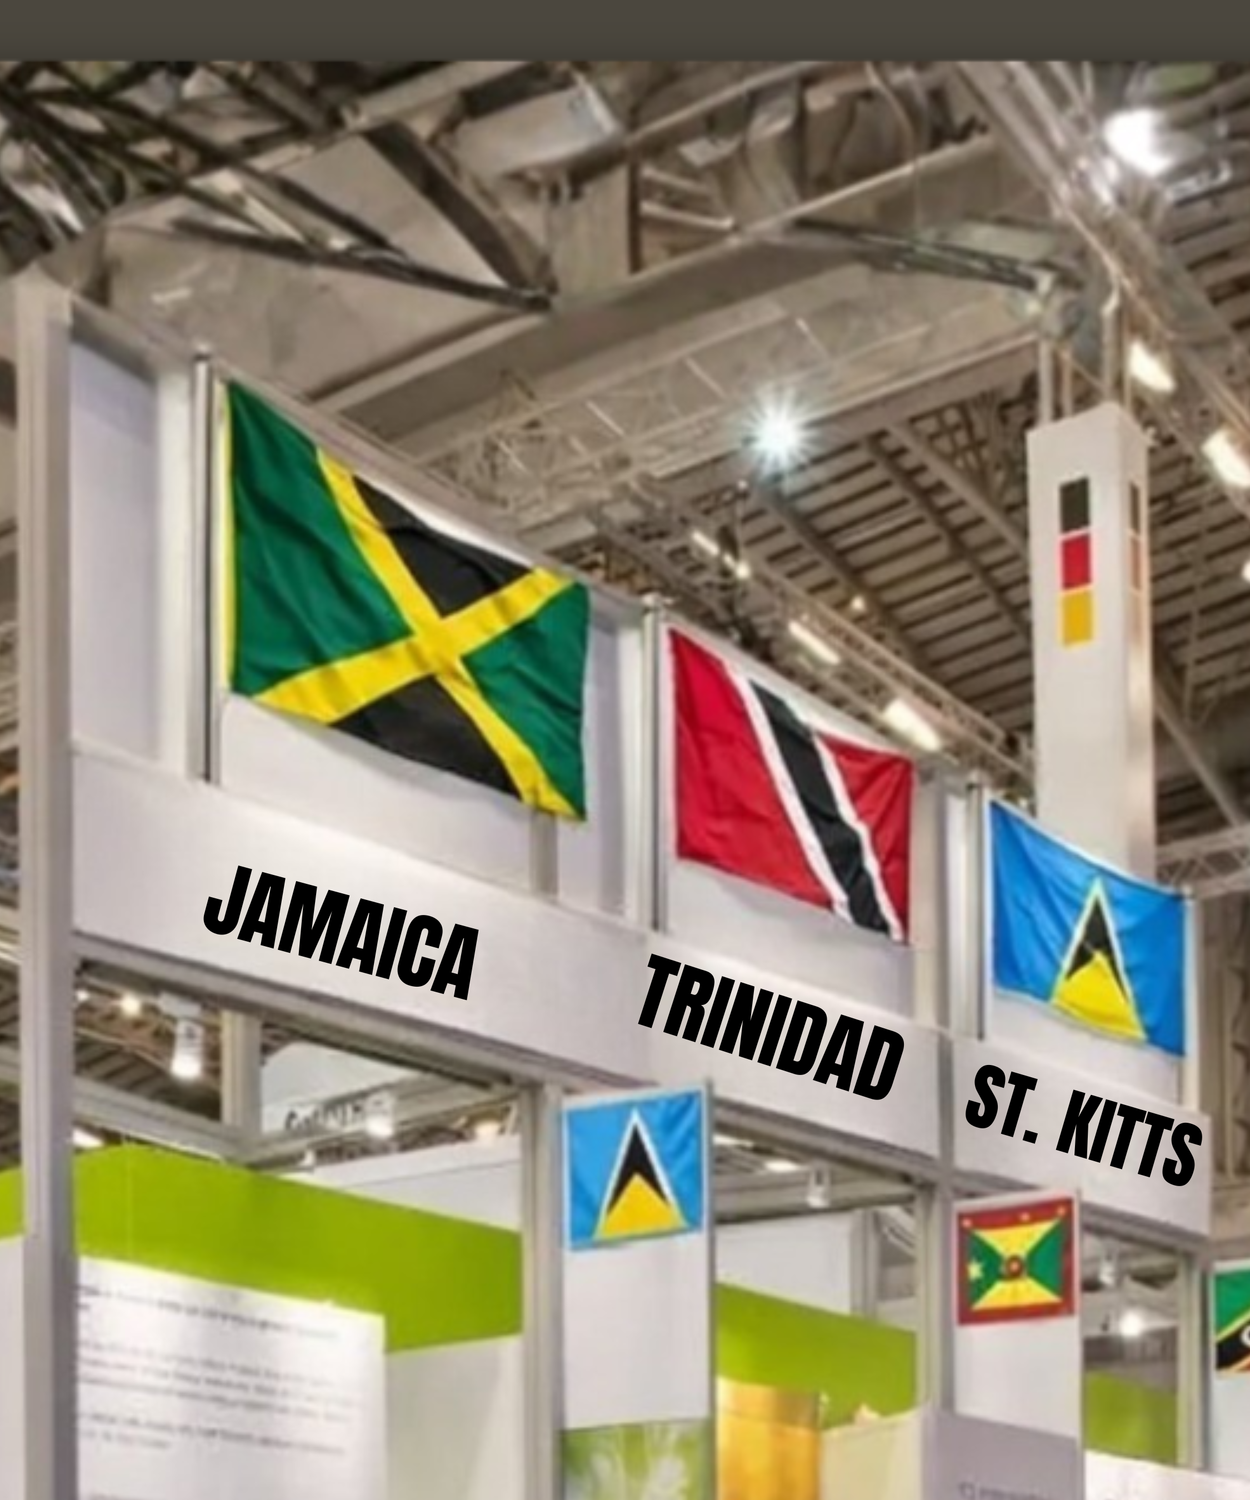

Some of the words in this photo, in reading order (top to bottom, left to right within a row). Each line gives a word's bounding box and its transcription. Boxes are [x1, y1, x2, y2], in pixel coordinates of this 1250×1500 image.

[203, 866, 479, 1000] JAMAICA
[638, 954, 905, 1101] TRINIDAD
[965, 1065, 1038, 1144] ST.
[1056, 1090, 1203, 1187] KITTS
